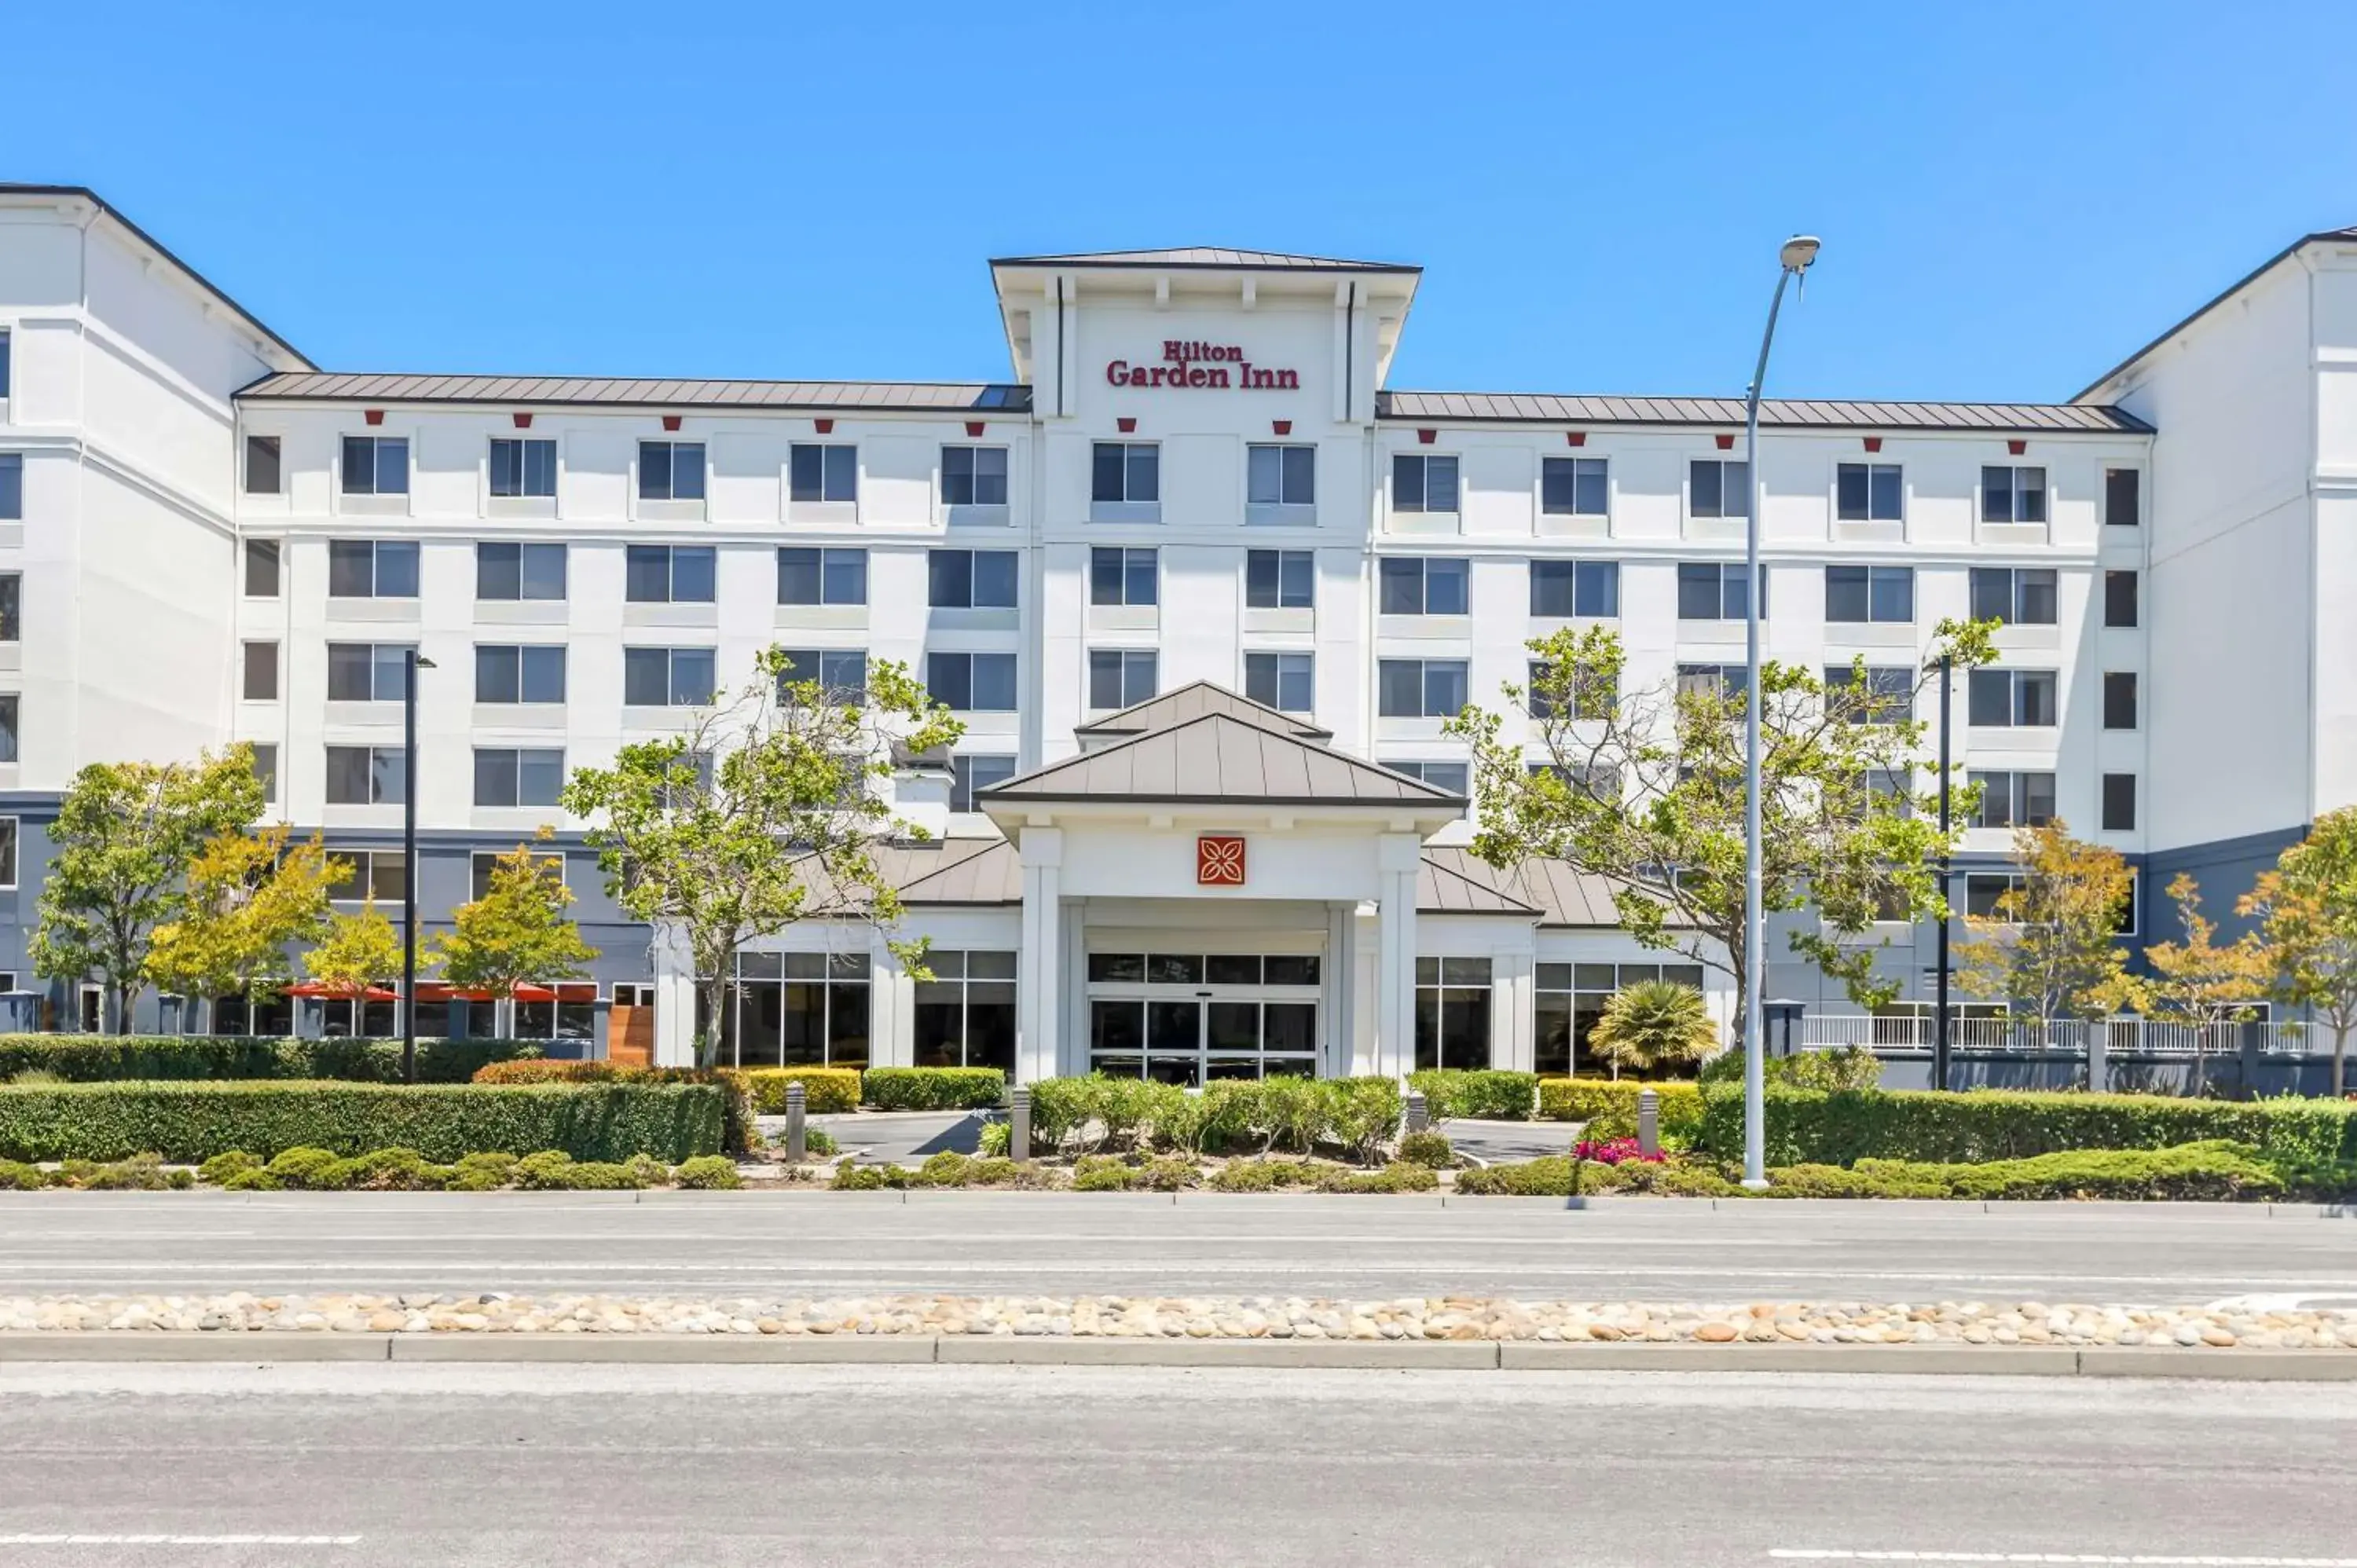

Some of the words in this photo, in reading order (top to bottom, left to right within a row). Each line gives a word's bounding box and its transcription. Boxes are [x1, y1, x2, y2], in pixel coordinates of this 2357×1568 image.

[1163, 340, 1244, 362] Hilton
[1106, 360, 1230, 387] Garden
[1239, 363, 1300, 390] Inn
